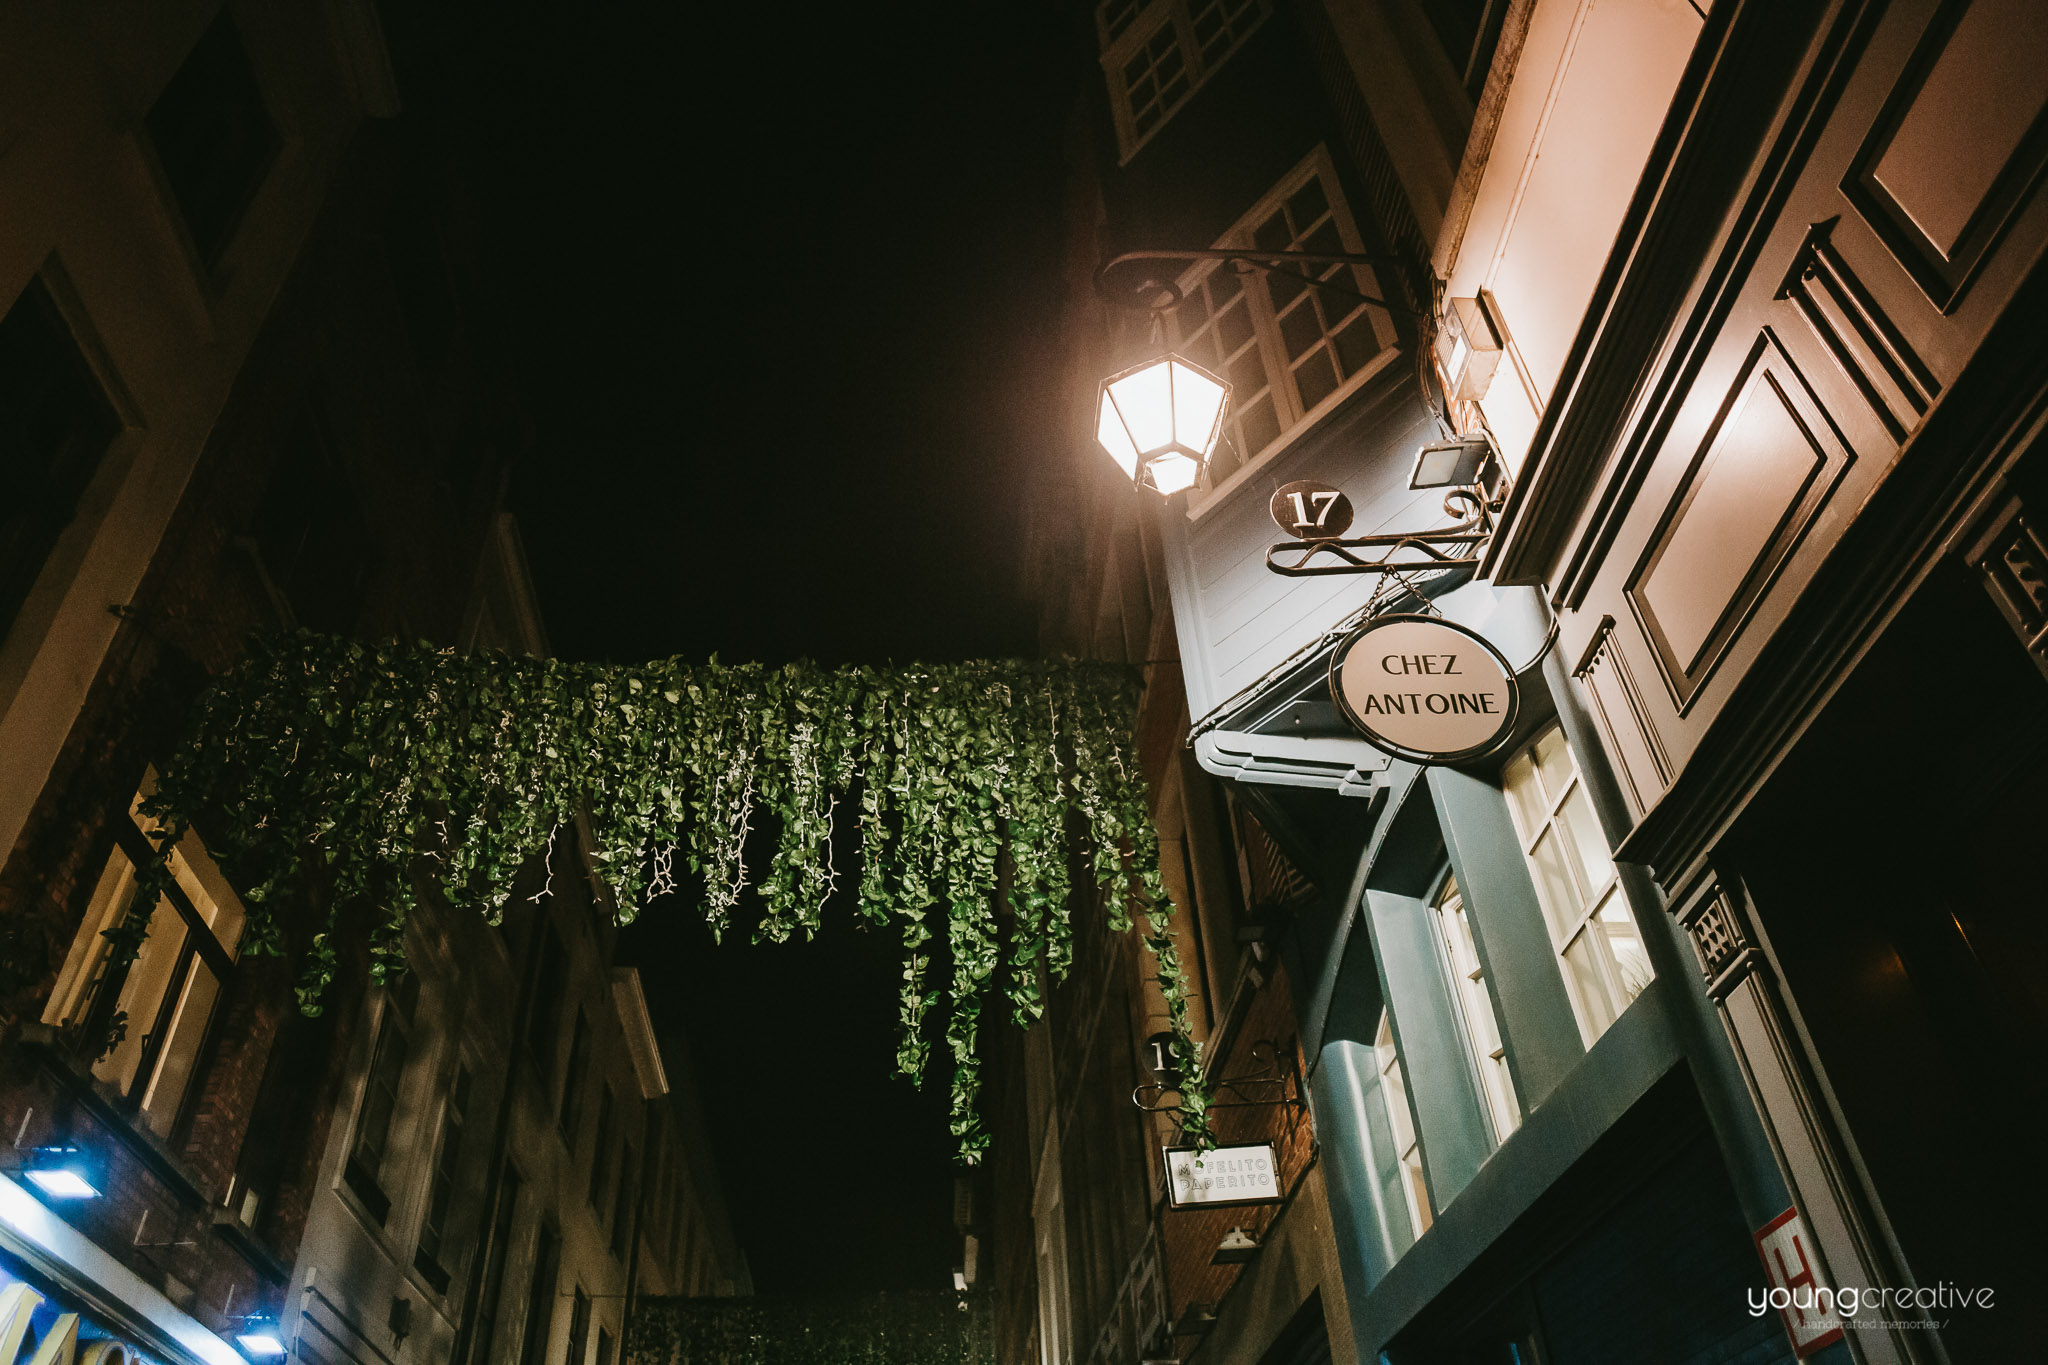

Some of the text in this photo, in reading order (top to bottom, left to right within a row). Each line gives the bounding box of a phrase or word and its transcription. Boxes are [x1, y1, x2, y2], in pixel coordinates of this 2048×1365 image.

[1286, 491, 1341, 528] 17
[1381, 654, 1463, 676] CHEZ
[1363, 692, 1500, 716] ANTOINE
[1179, 1173, 1270, 1192] PAPERITO
